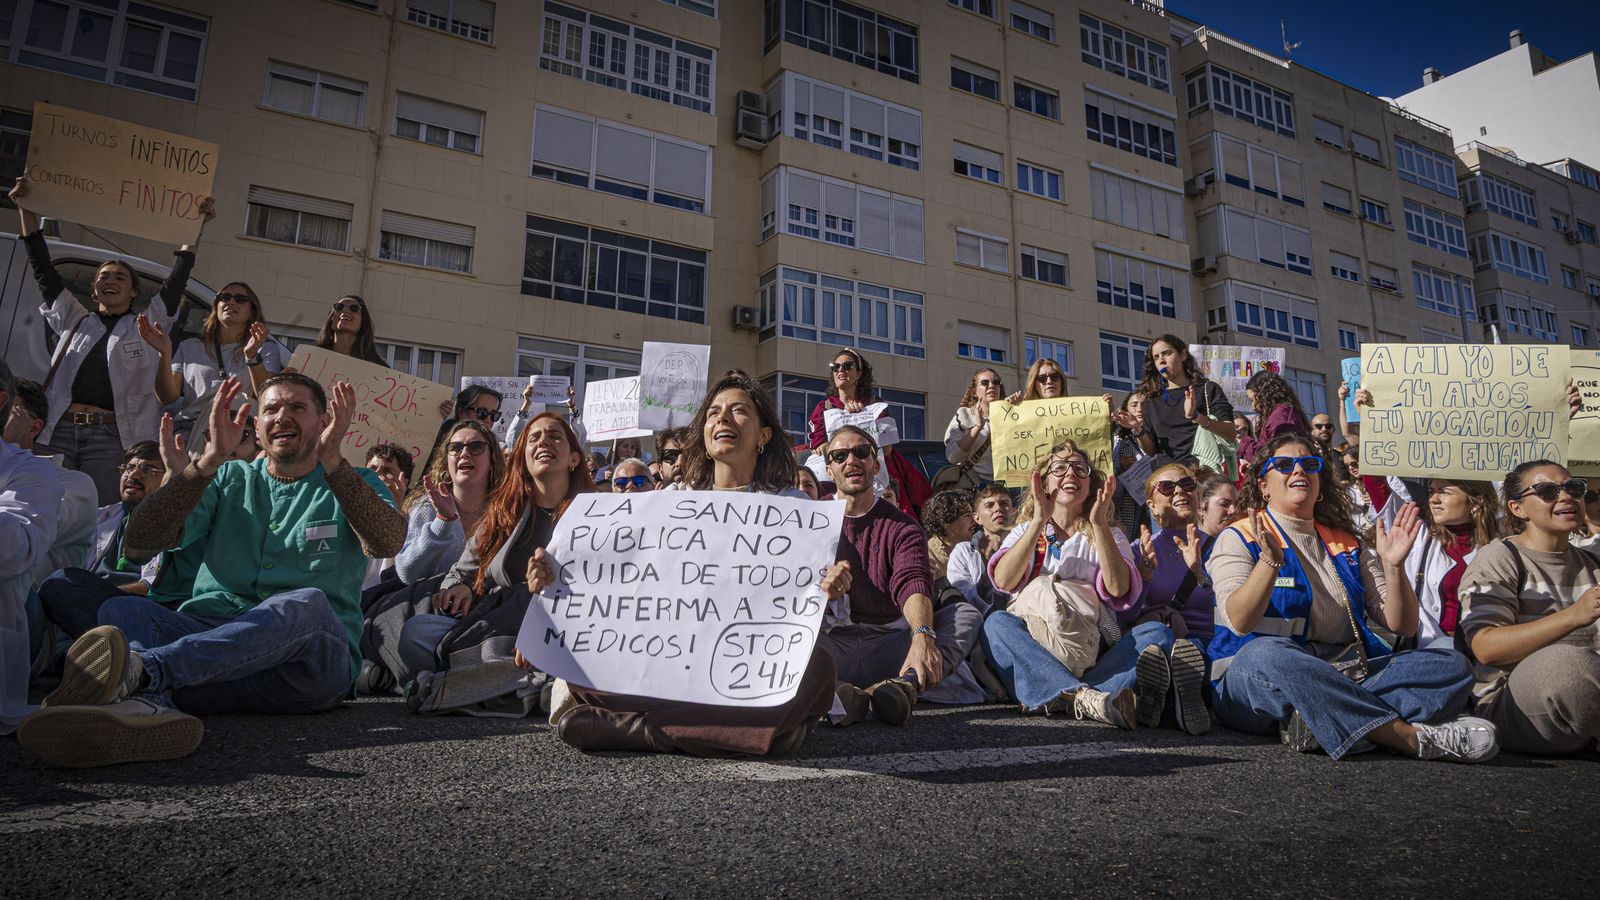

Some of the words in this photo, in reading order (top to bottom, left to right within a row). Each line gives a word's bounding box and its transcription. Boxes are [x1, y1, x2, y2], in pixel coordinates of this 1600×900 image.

[43, 112, 118, 149] TURNOS
[30, 164, 104, 195] CONTRATOS
[1367, 346, 1394, 374] A
[1459, 346, 1494, 377] YO
[1511, 347, 1549, 377] DE
[593, 382, 625, 402] LLEVO
[1398, 378, 1432, 408] 14
[1443, 377, 1529, 409] AÑOS
[1577, 380, 1598, 388] QUE
[588, 401, 639, 417] TRABAJAN
[1413, 404, 1554, 440] VOCACIÓN
[1013, 429, 1034, 440] SER
[1006, 453, 1029, 472] NO
[1364, 442, 1399, 467] ES
[1408, 441, 1451, 469] UN
[584, 498, 632, 518] LA
[669, 500, 830, 531] SANIDAD
[569, 520, 707, 553] PÚBLICA
[732, 533, 792, 557] NO
[559, 560, 660, 586] CUIDA
[681, 561, 719, 586] DE
[733, 597, 753, 620] A
[771, 596, 822, 621] SUS
[544, 622, 696, 671] MÉDICOS!
[723, 631, 803, 658] STOP
